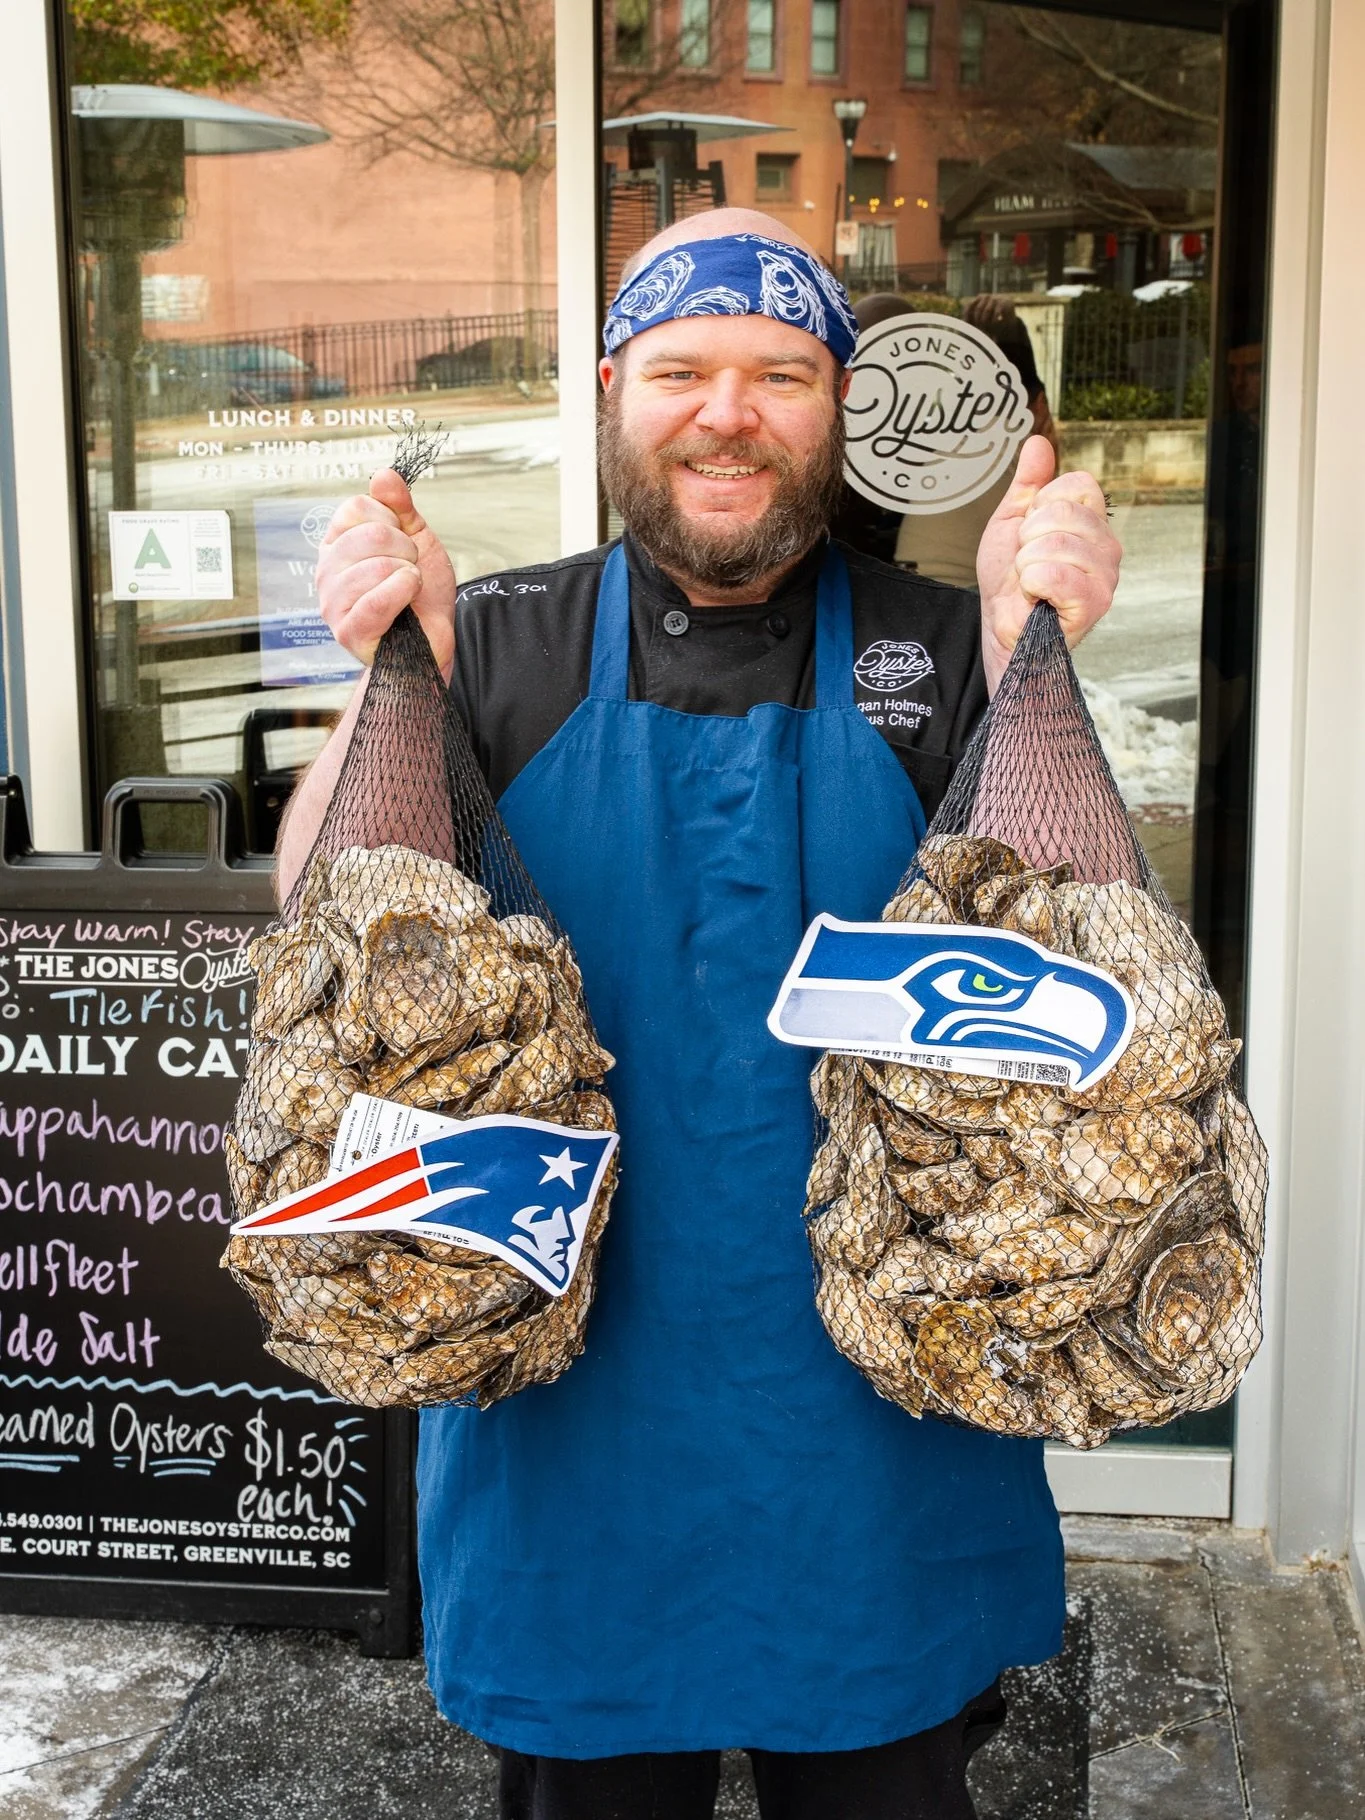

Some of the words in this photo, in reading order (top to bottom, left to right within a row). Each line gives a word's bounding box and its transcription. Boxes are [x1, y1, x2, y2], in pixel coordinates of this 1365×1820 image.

[889, 337, 976, 371] JONES
[208, 410, 291, 428] LUNCH
[300, 409, 316, 427] &
[324, 408, 416, 427] DINNER
[844, 363, 1025, 458] Oyster
[178, 441, 224, 457] MON
[250, 440, 322, 457] THURS
[134, 528, 172, 569] A
[455, 580, 510, 604] Table
[514, 584, 547, 594] 301
[853, 649, 935, 678] Oyster
[881, 643, 920, 654] JONES
[865, 715, 884, 726] us
[888, 713, 921, 728] Chef
[884, 698, 932, 717] Holmes
[74, 918, 171, 947] Warm!
[181, 919, 255, 949] Stay
[14, 954, 74, 978] THE
[80, 956, 179, 980] JONES
[0, 1098, 229, 1161] ppahanno
[371, 1132, 382, 1154] Oyster
[0, 1310, 57, 1367] de
[79, 1311, 160, 1368] Salt
[0, 1402, 95, 1449] amed
[110, 1402, 233, 1474] Oysters
[245, 1407, 346, 1481] $1.50
[237, 1480, 334, 1523] each!
[0, 1512, 83, 1531] .549.0301
[100, 1517, 350, 1542] THEJONESOYSTERCO.COM
[22, 1538, 92, 1557] COURT
[97, 1541, 179, 1563] STREET,
[184, 1545, 317, 1568] GREENVILLE,
[323, 1552, 351, 1569] SC
